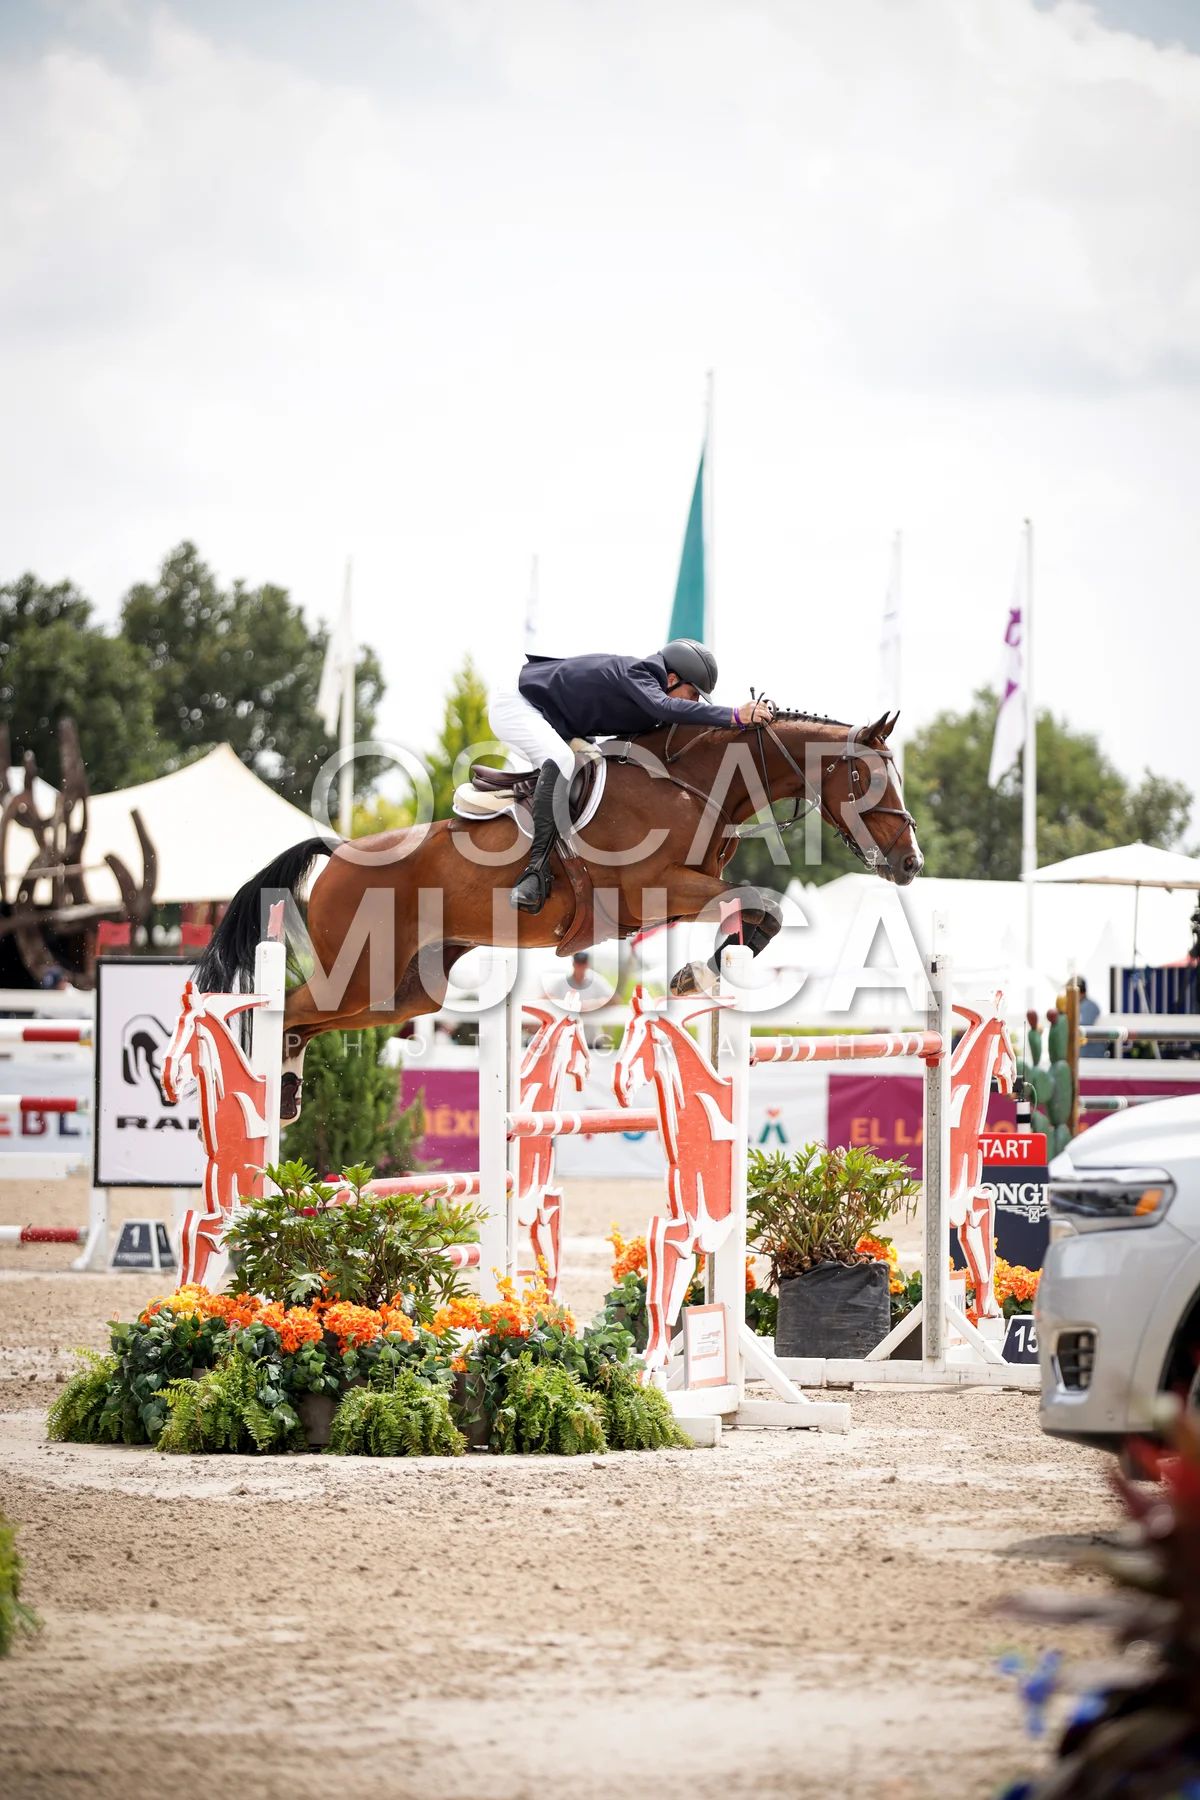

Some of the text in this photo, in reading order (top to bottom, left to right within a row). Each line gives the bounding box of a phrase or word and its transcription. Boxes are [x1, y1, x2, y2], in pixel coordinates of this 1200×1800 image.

[851, 1117, 886, 1145] EL
[978, 1139, 1032, 1158] TART
[130, 1225, 141, 1248] 1
[1014, 1325, 1038, 1353] 15
